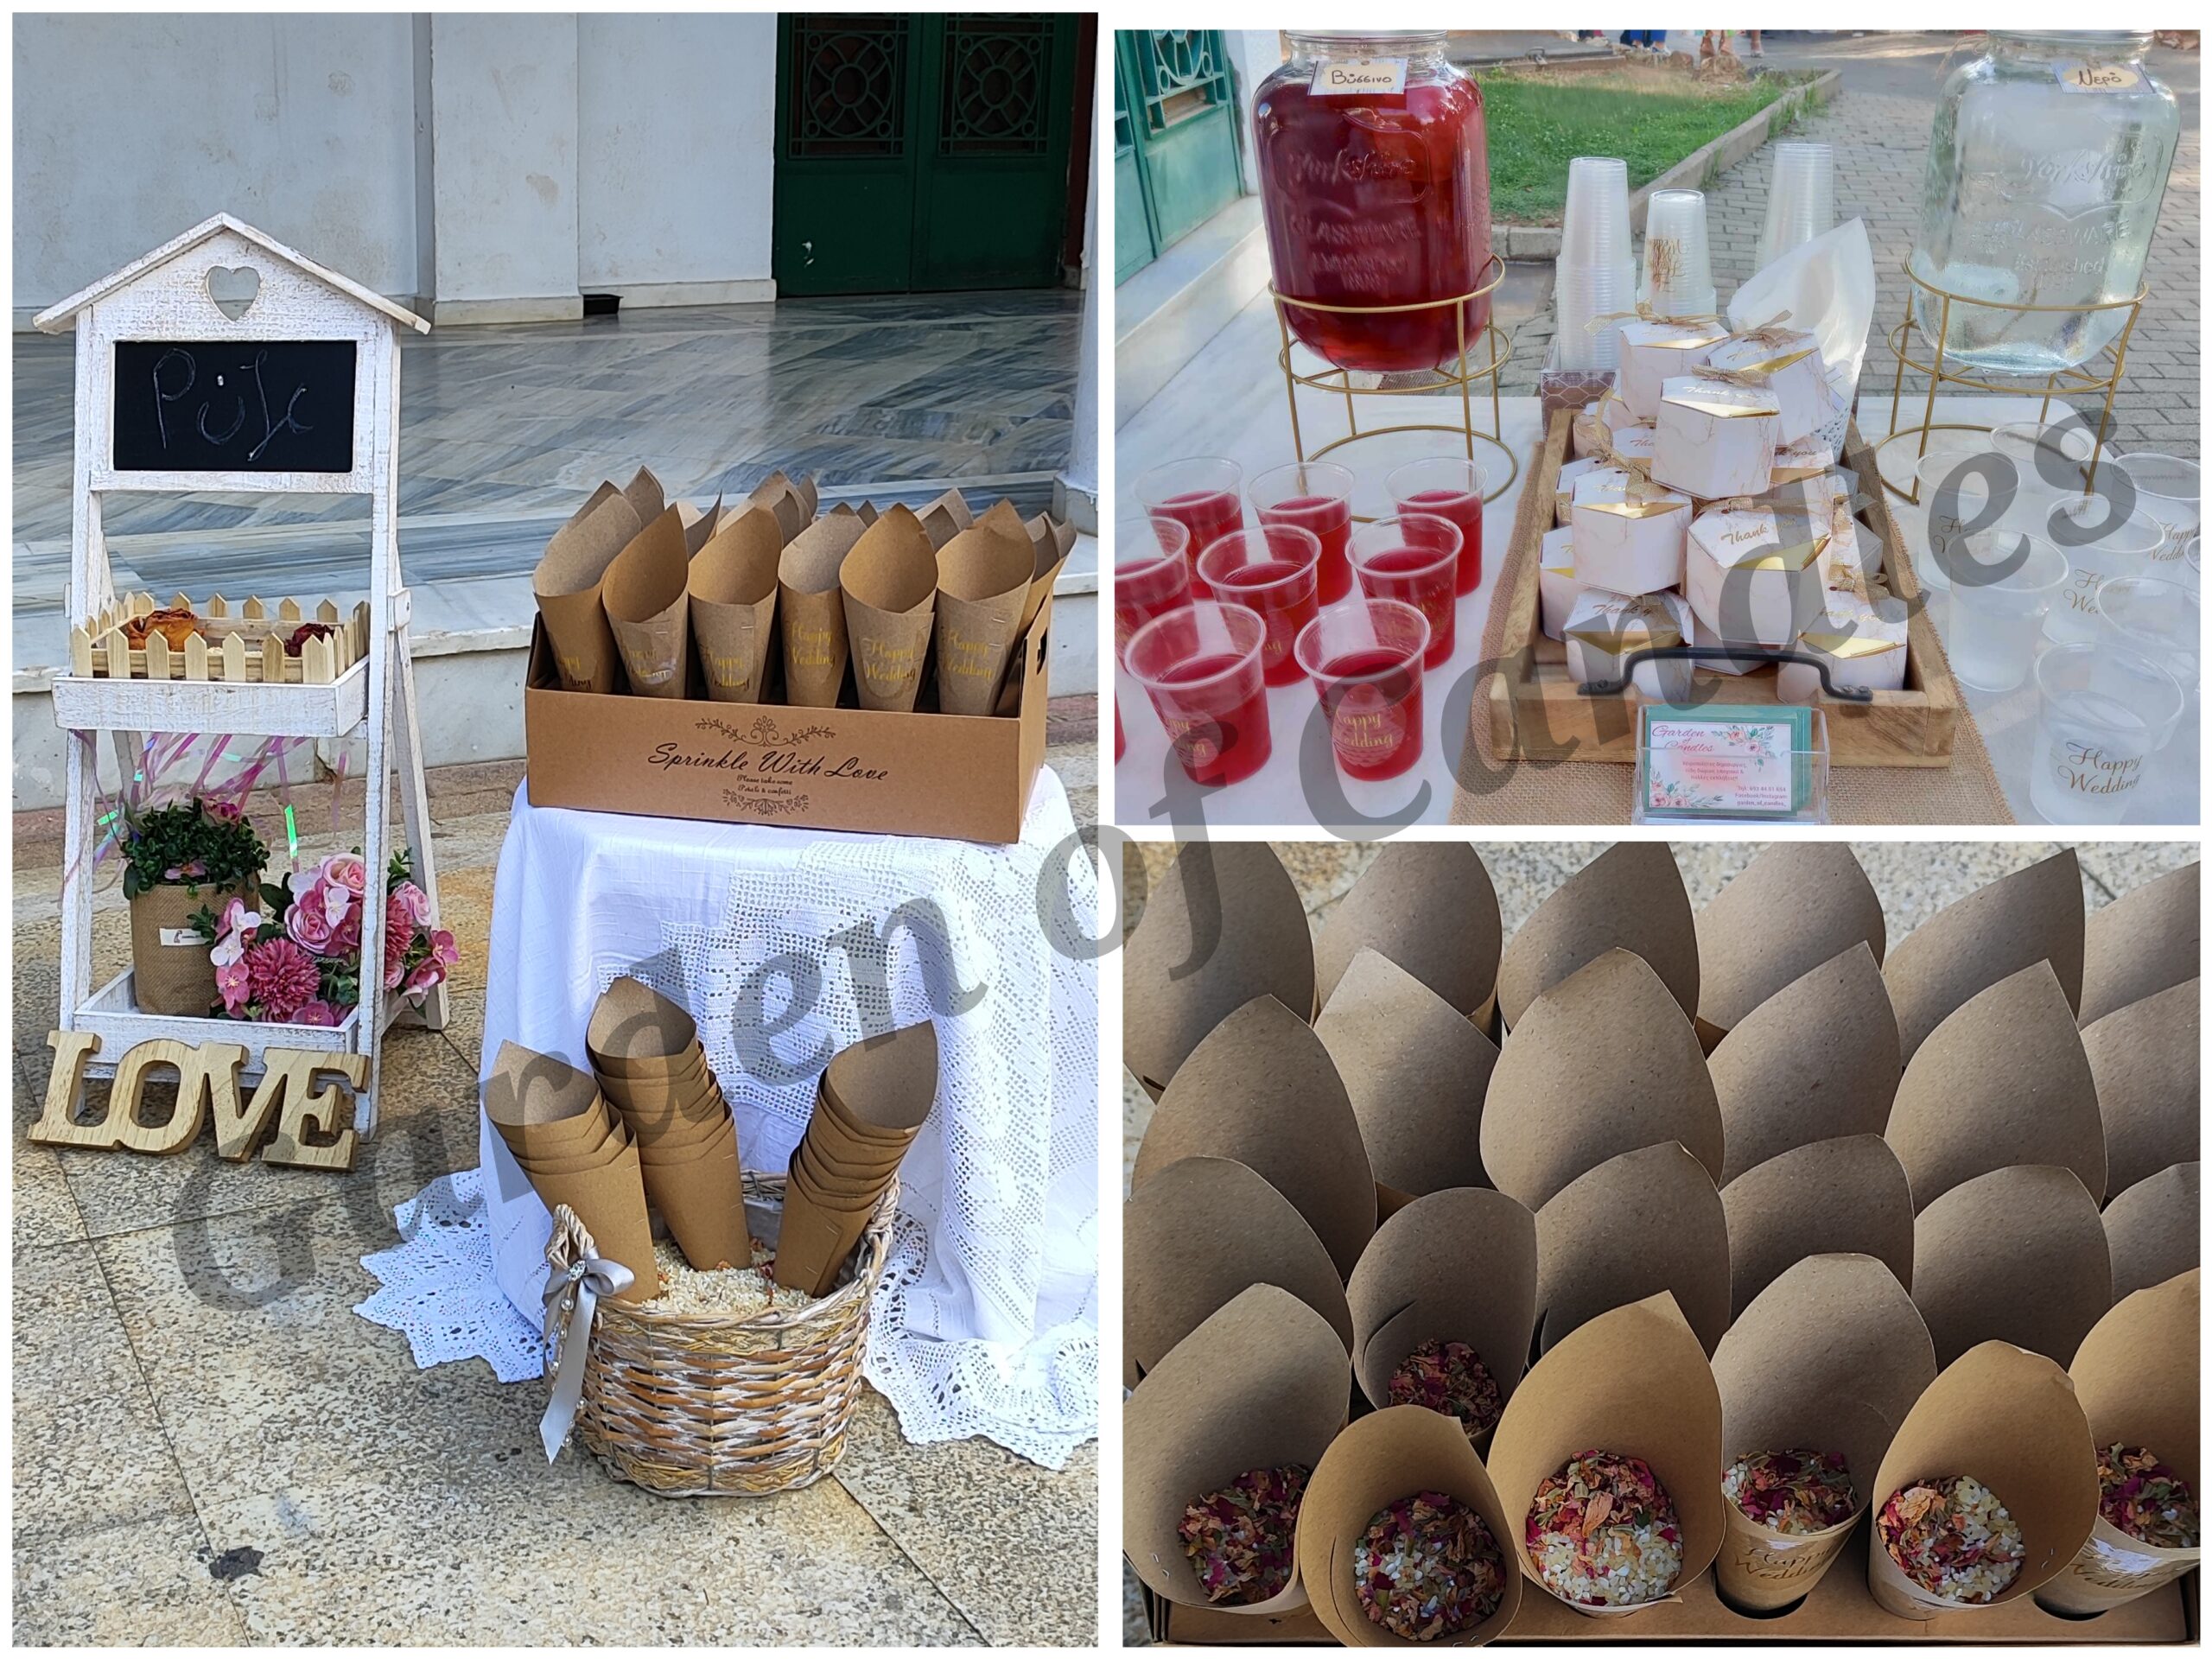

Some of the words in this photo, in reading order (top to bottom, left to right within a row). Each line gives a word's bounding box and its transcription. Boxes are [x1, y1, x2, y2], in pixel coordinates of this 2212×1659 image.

[1720, 524, 1769, 545] Thank
[1651, 725, 1706, 737] Garden
[647, 742, 749, 771] Sprinkle
[758, 750, 825, 775] With
[823, 756, 889, 781] Love
[2066, 741, 2143, 775] Happy
[2057, 766, 2142, 795] Wedding
[27, 1029, 372, 1173] LOVE
